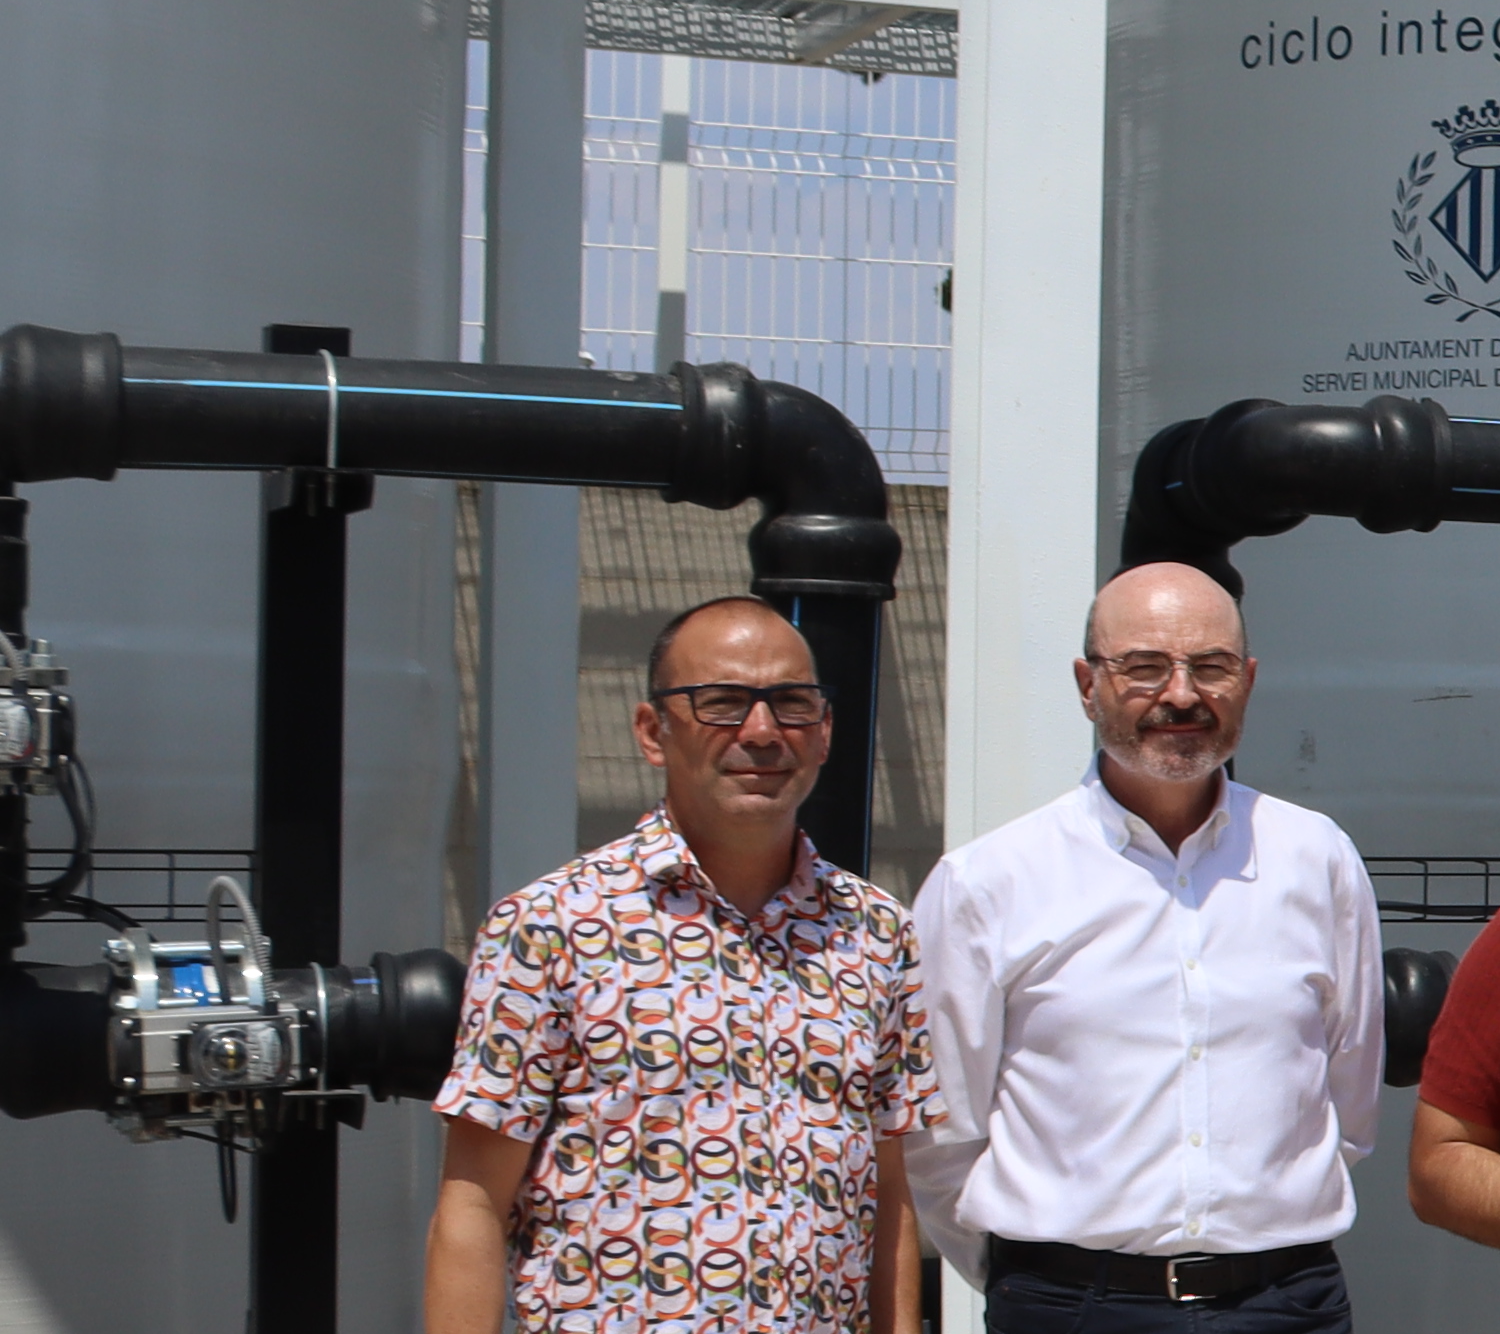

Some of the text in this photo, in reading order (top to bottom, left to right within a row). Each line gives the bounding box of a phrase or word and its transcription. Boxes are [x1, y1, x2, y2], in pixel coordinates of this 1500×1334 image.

[1240, 14, 1353, 70] ciclo
[1345, 338, 1485, 362] AJUNTAMENT
[1302, 371, 1367, 394] SERVEI
[1373, 368, 1488, 390] MUNICIPAL
